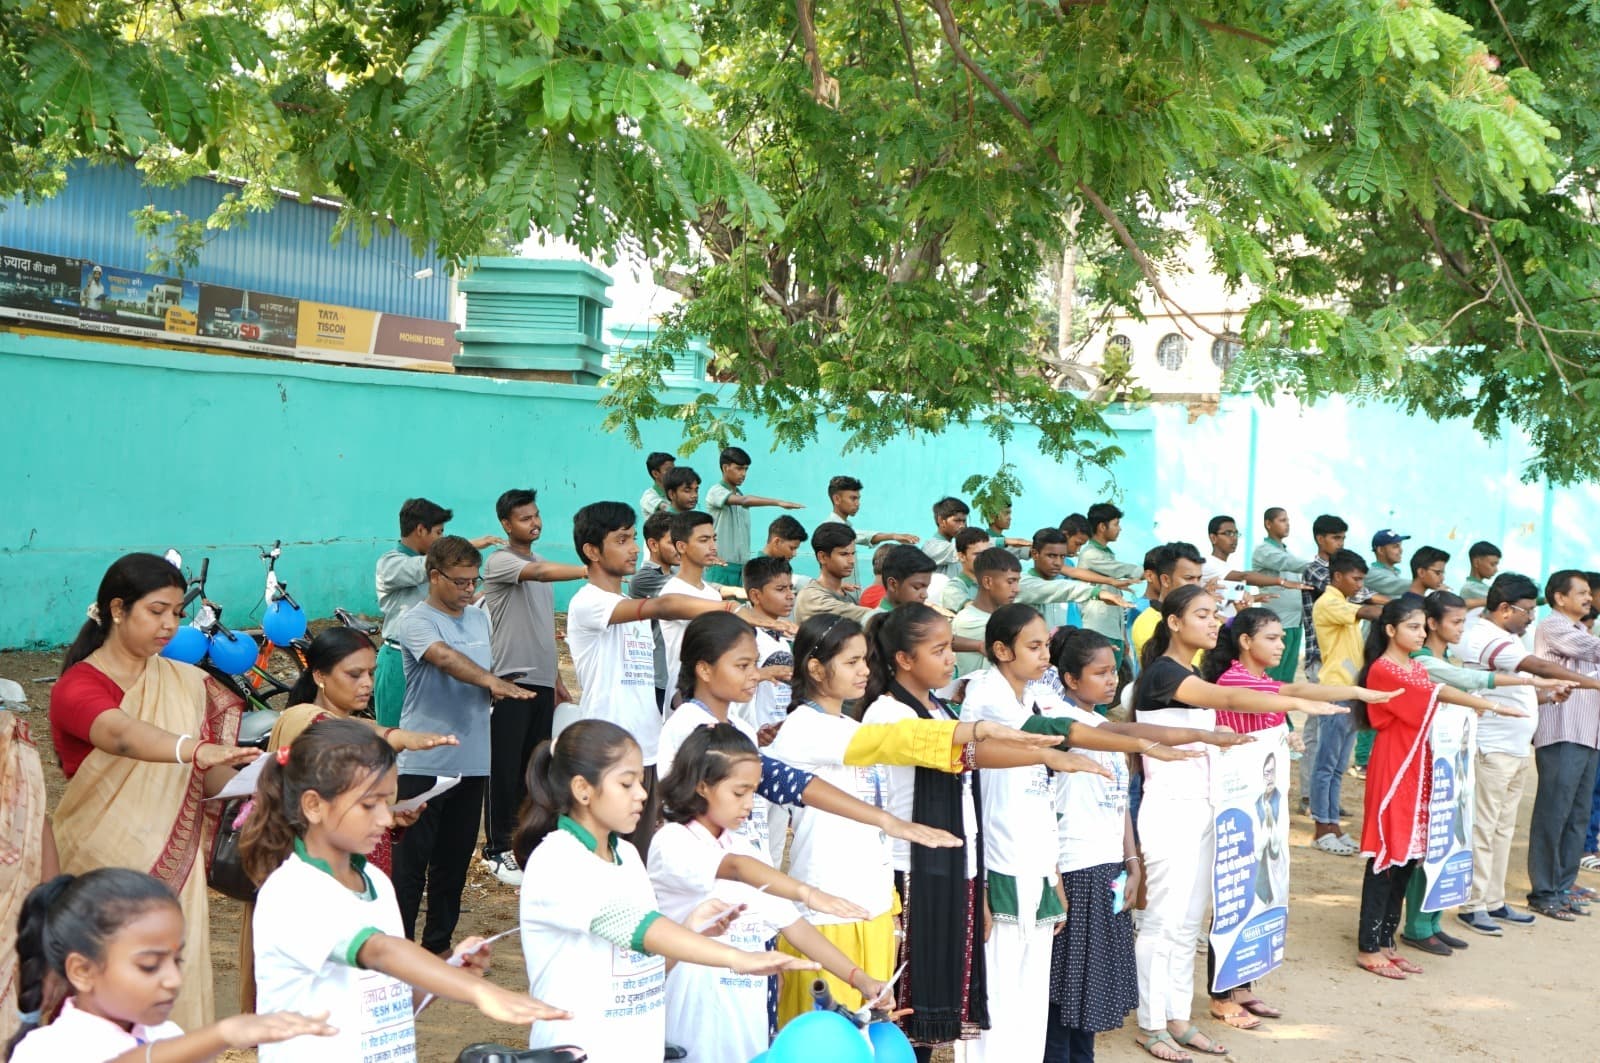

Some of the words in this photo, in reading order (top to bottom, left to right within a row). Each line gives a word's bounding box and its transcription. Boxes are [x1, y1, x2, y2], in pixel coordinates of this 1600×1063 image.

[318, 309, 339, 320] TATA
[317, 321, 346, 334] TISCON
[399, 332, 424, 344] MOHINI
[424, 335, 446, 347] STORE
[615, 994, 626, 1004] 02
